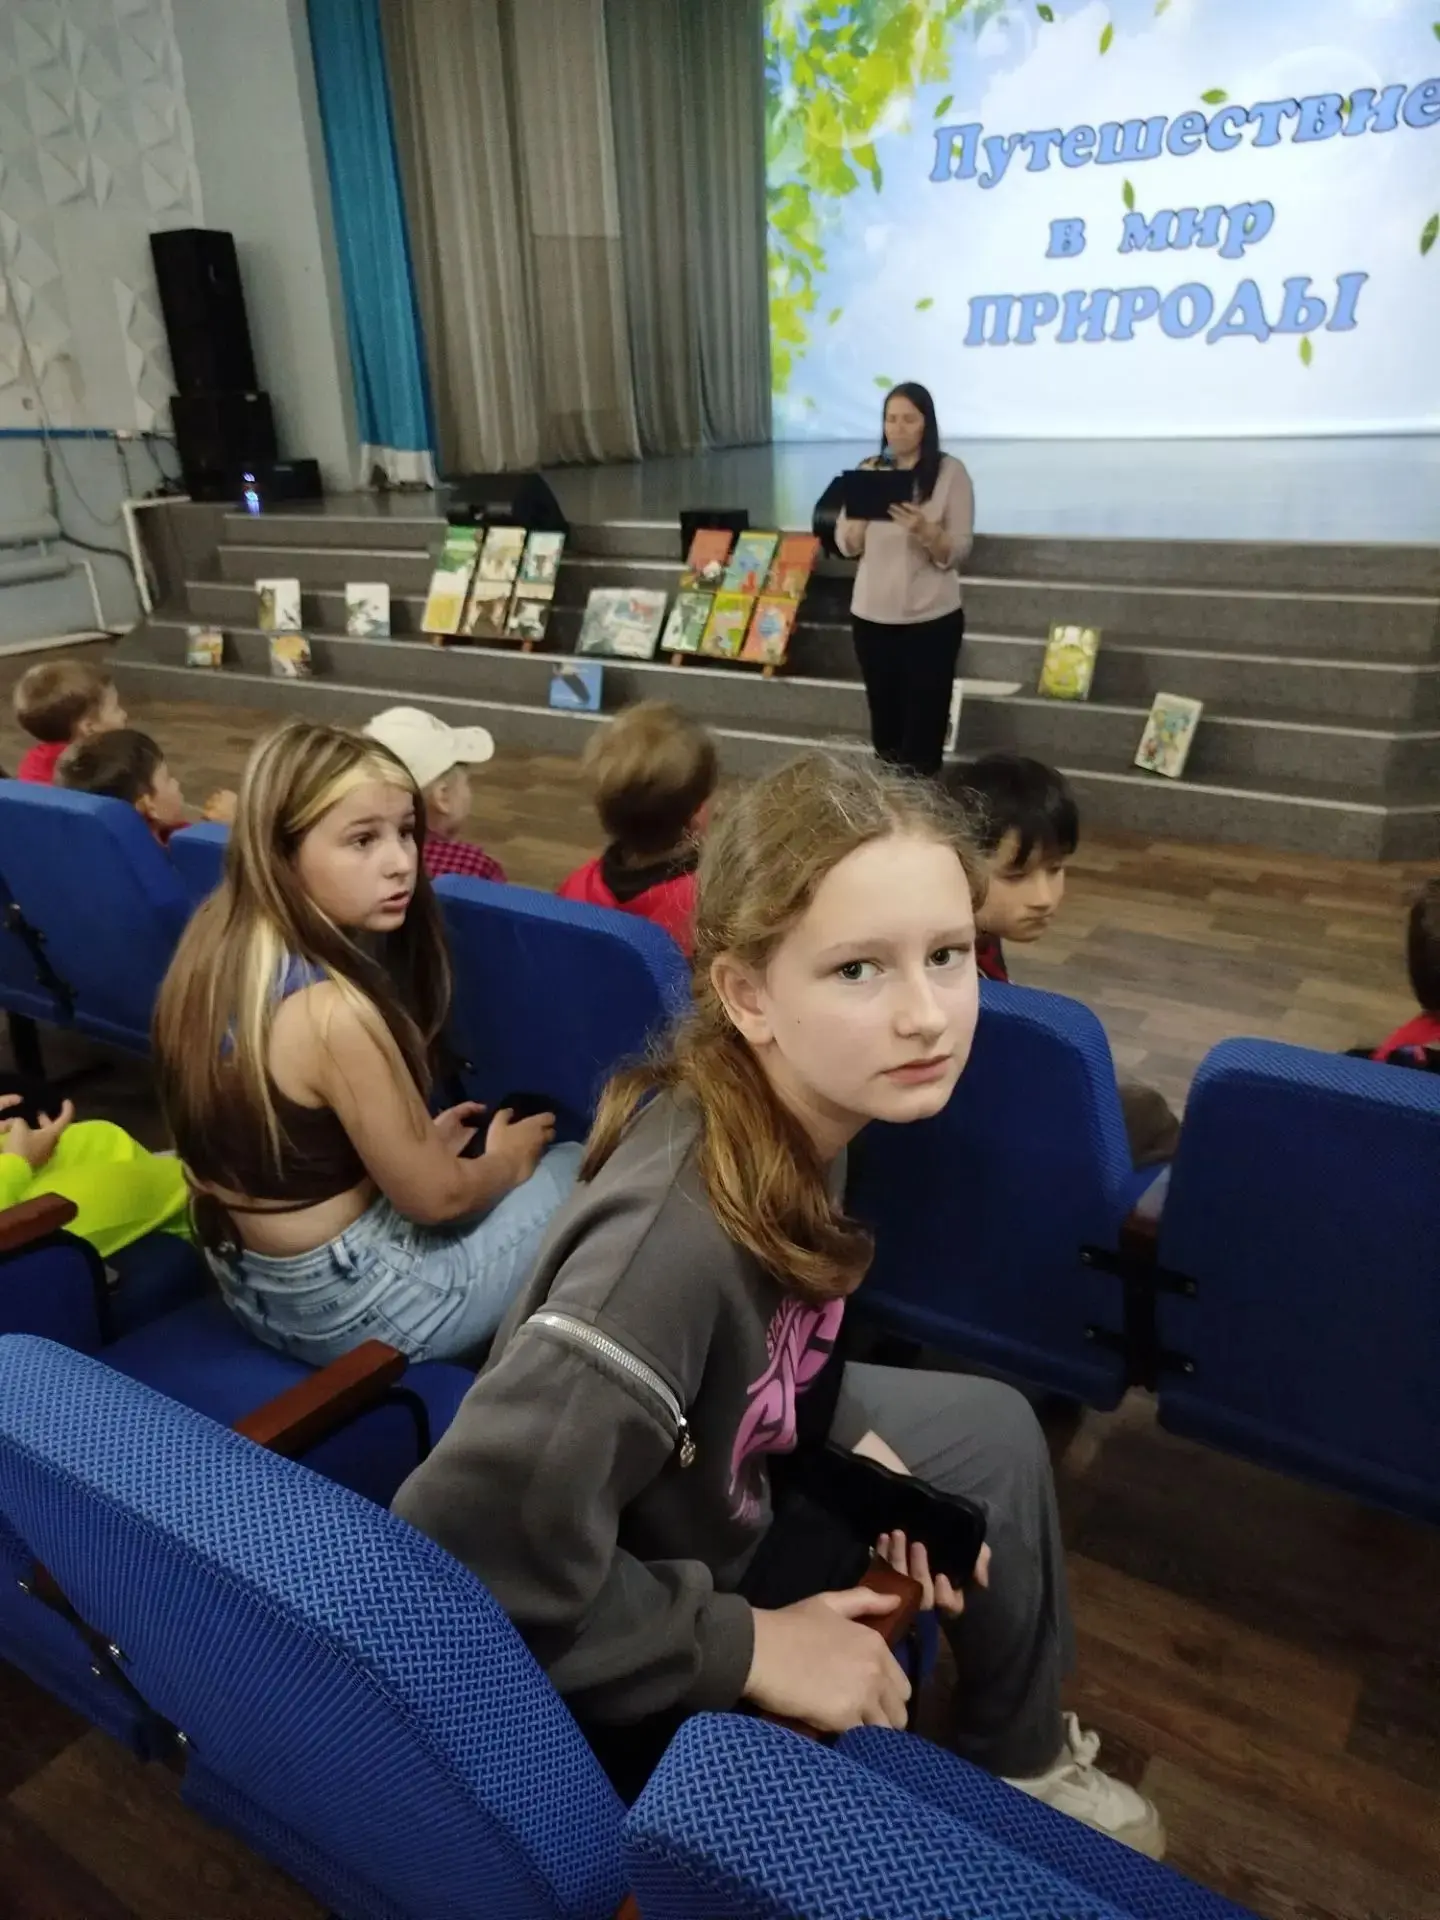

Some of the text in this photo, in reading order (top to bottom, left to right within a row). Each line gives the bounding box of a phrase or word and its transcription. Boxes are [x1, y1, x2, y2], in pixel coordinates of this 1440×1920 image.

[929, 77, 1440, 188] Путешествие
[1046, 201, 1275, 258] в мир
[964, 272, 1369, 346] ПРИРОДЫ
